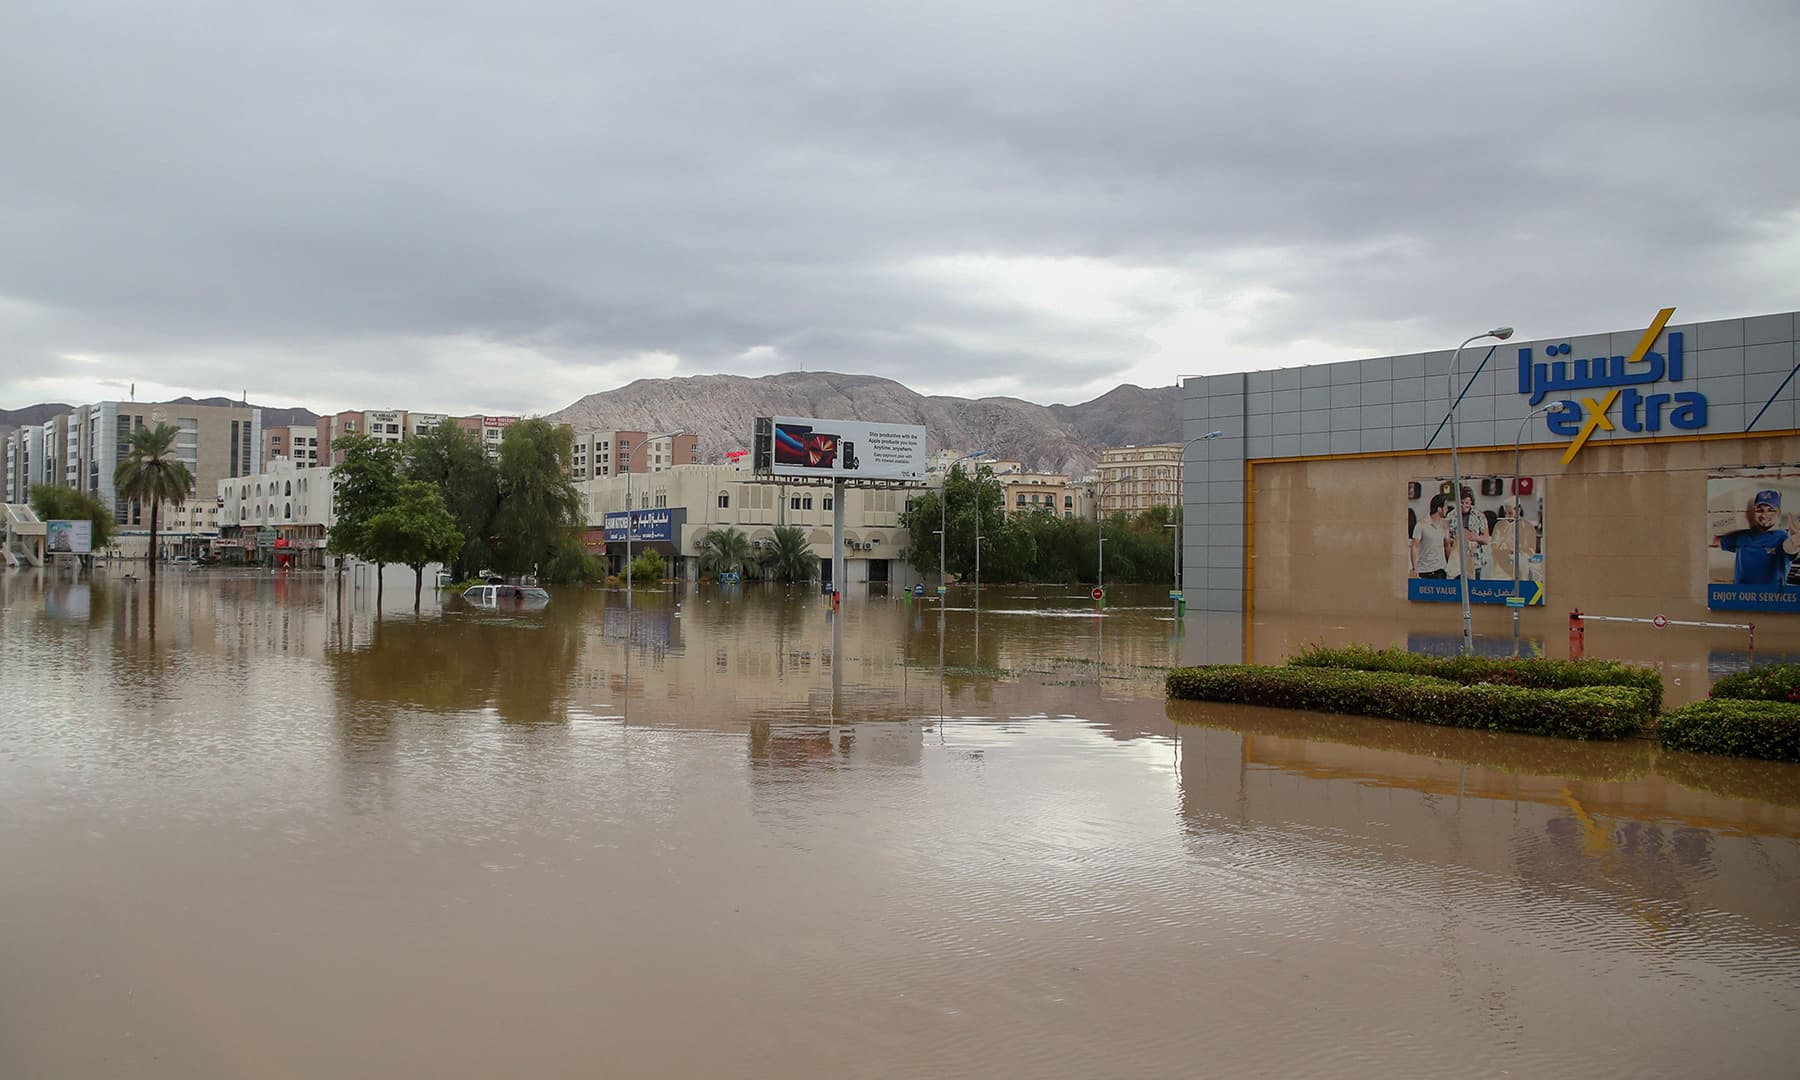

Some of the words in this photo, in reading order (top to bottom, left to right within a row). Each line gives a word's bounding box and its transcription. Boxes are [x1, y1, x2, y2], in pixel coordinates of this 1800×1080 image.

[1518, 307, 1683, 406] اكسترا
[1546, 388, 1708, 465] extra
[1419, 586, 1434, 595] BEST
[1435, 586, 1457, 595] VALUE
[1712, 591, 1737, 602] ENJOY
[1738, 591, 1757, 601] OUR
[1759, 592, 1797, 603] SERVICES
